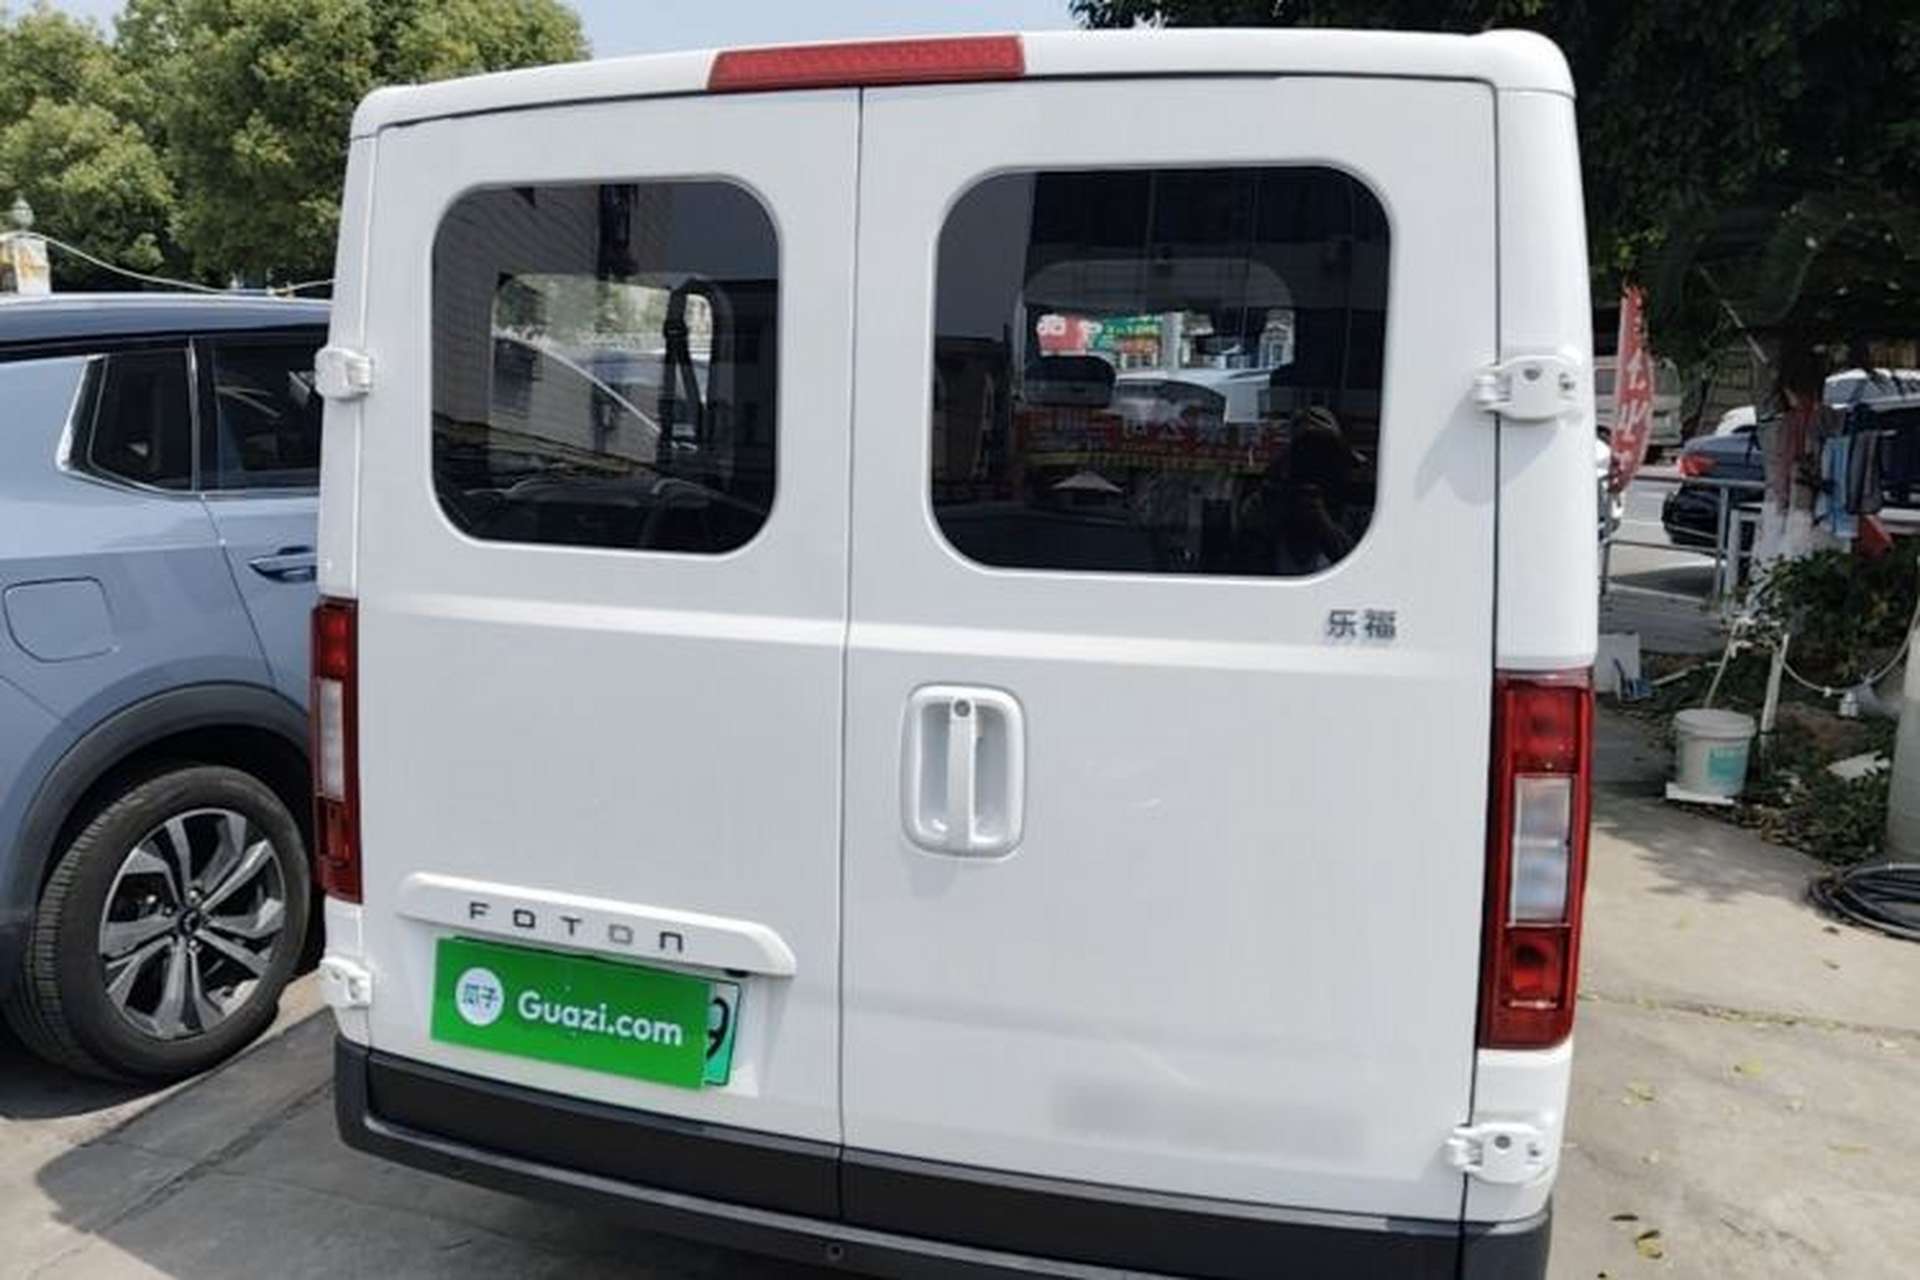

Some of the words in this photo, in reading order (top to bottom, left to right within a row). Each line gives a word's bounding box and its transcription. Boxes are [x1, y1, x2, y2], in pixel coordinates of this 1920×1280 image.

[1326, 608, 1396, 638] 乐福
[469, 902, 684, 953] FOTON
[517, 990, 683, 1047] Guazi.com
